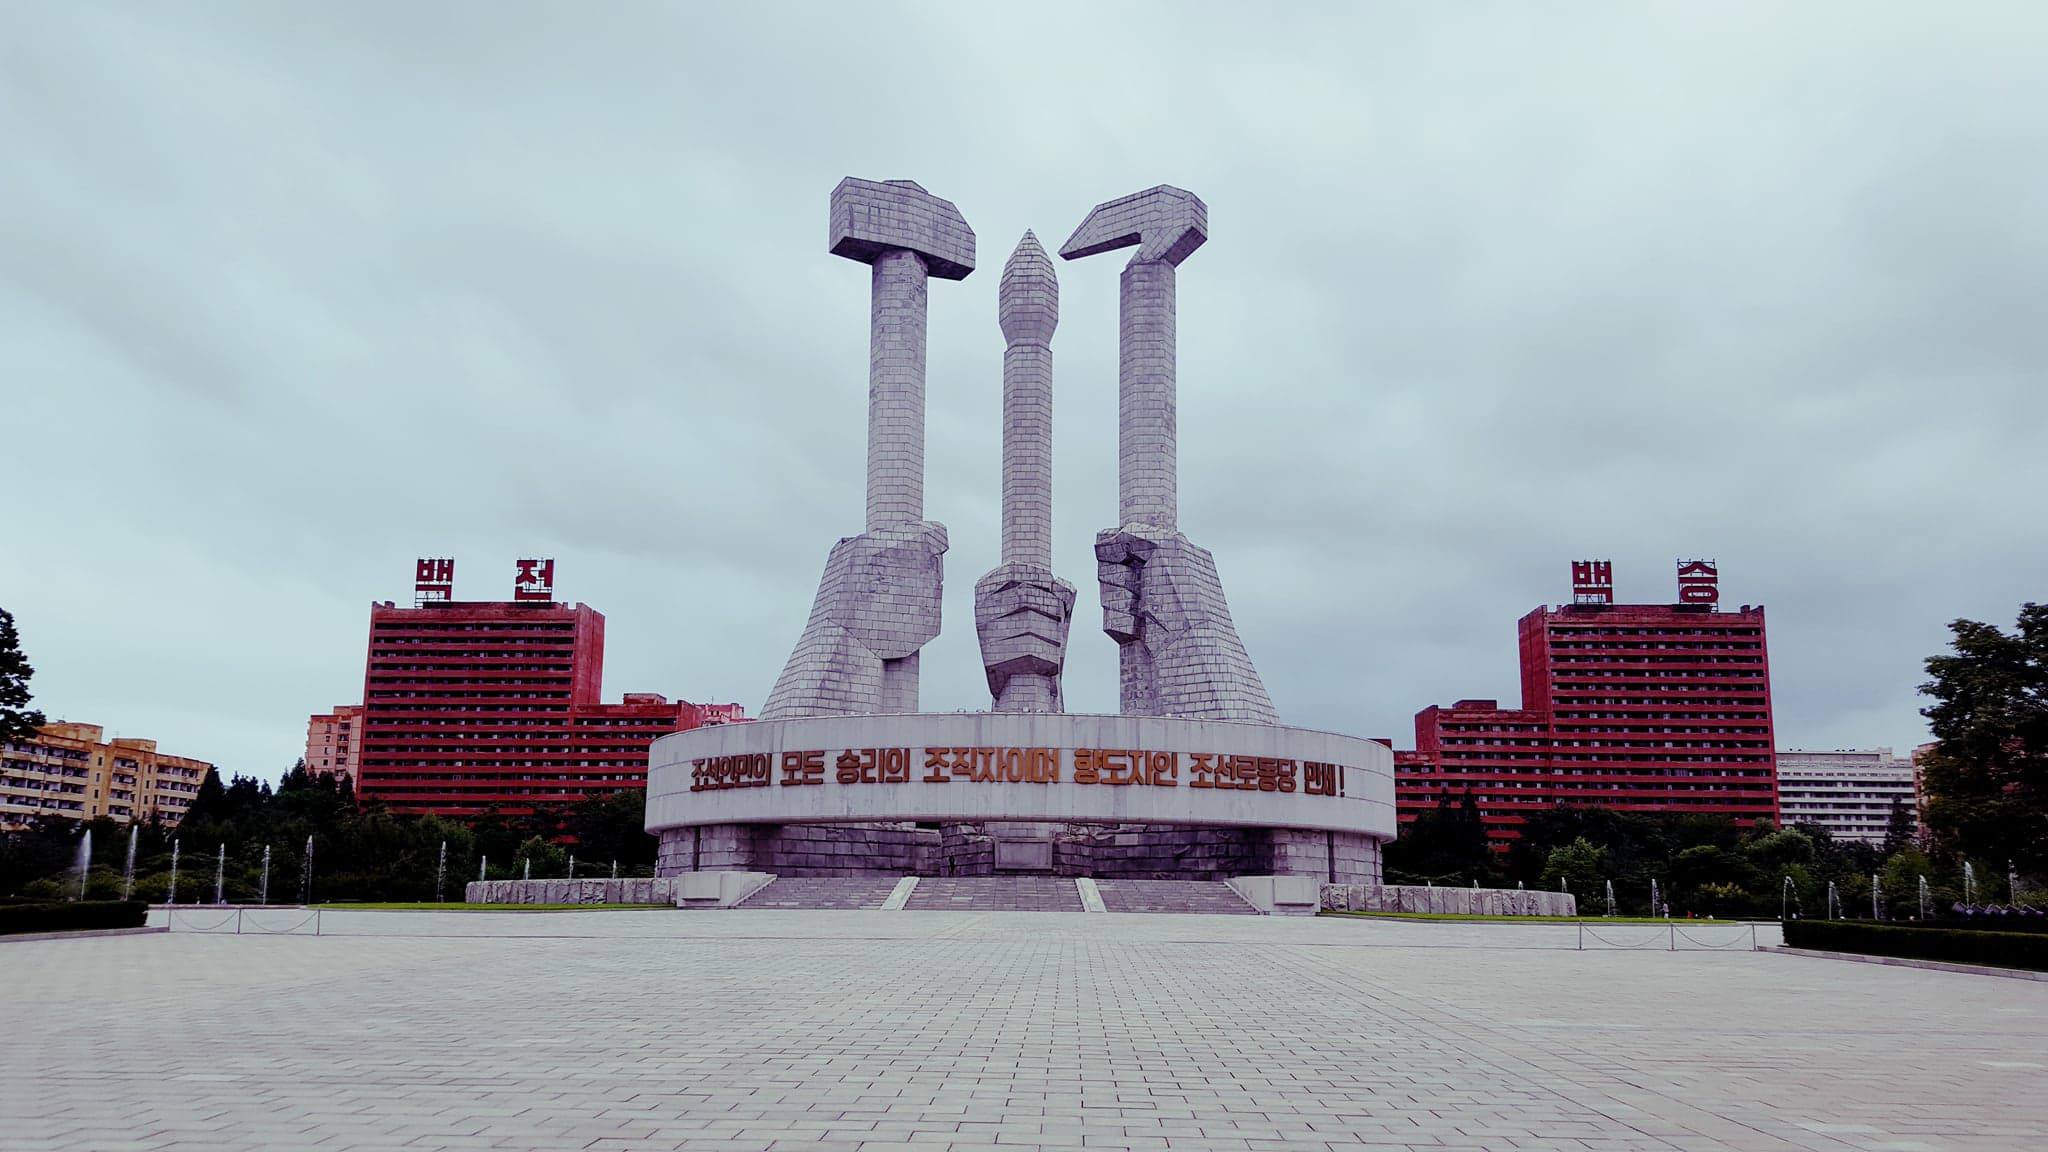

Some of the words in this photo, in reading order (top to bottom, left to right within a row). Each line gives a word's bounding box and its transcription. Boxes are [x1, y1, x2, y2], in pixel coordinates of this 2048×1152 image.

[415, 558, 454, 600] 백
[515, 559, 554, 600] 전
[1572, 560, 1613, 603] 백
[1678, 560, 1719, 603] 승
[690, 753, 772, 792] 조선인민의
[780, 750, 825, 786] 모든
[836, 748, 910, 783] 승리의
[923, 747, 1060, 783] 조직자이며
[1074, 748, 1178, 787] 향도자인
[1189, 752, 1298, 793] 조선로동당
[1303, 761, 1346, 798] 만세!
